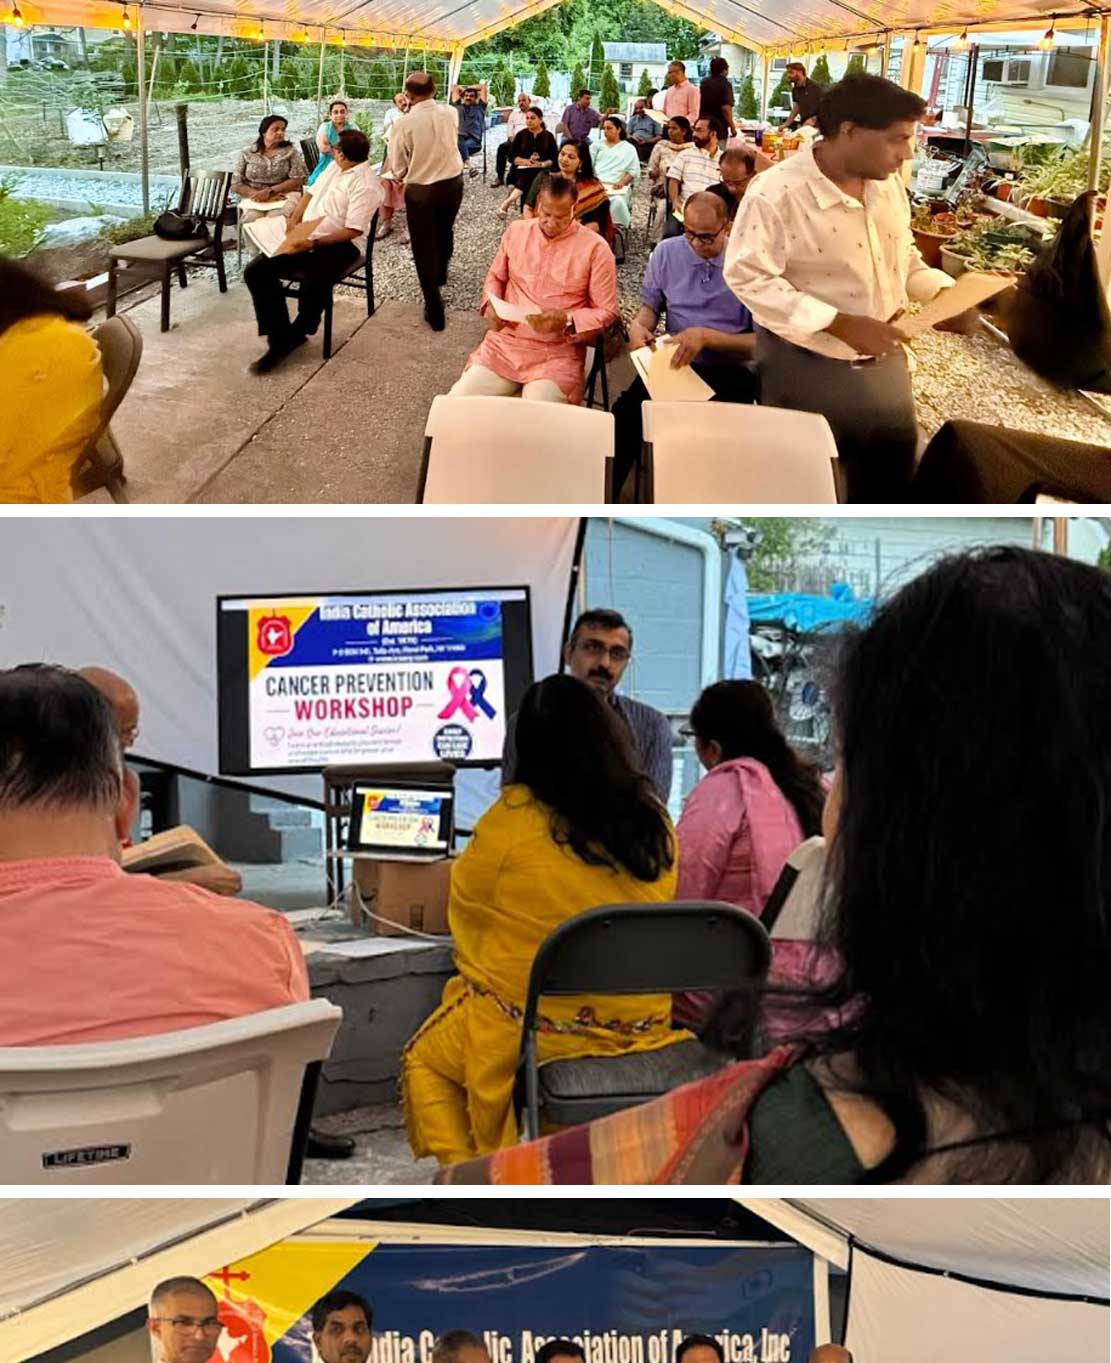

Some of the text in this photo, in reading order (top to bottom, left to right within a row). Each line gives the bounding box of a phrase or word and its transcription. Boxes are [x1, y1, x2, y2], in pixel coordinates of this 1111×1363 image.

[382, 619, 432, 635] America
[265, 671, 434, 697] CANCER PREVENTION
[294, 696, 414, 721] WORKSHOP
[761, 1327, 791, 1363] Inc
